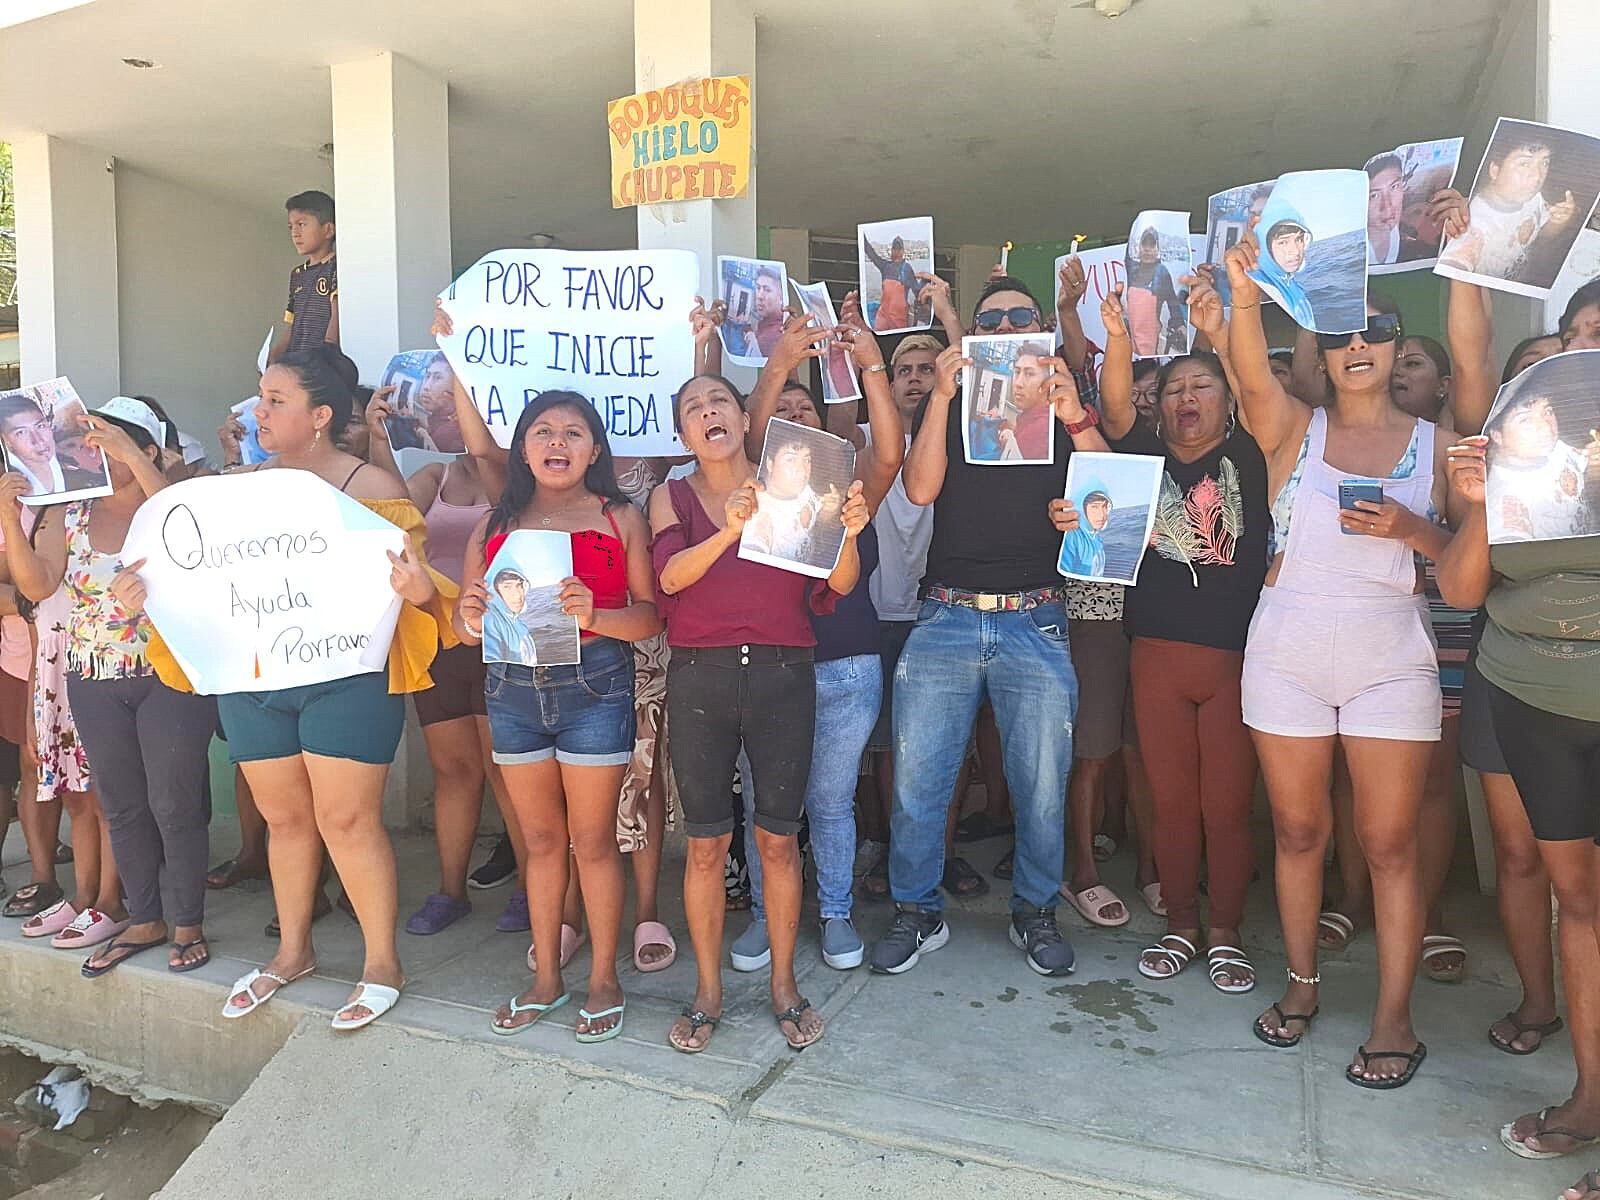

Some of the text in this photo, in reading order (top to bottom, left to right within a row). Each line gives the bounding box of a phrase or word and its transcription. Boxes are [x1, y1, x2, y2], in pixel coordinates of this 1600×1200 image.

[609, 78, 749, 149] BODOQUES
[620, 161, 736, 205] CHUPETE
[479, 260, 551, 308] POR
[563, 265, 663, 311] FAVOR
[465, 325, 659, 377] QUE INICIE
[163, 503, 328, 570] Queremos
[231, 577, 312, 628] Ayuda
